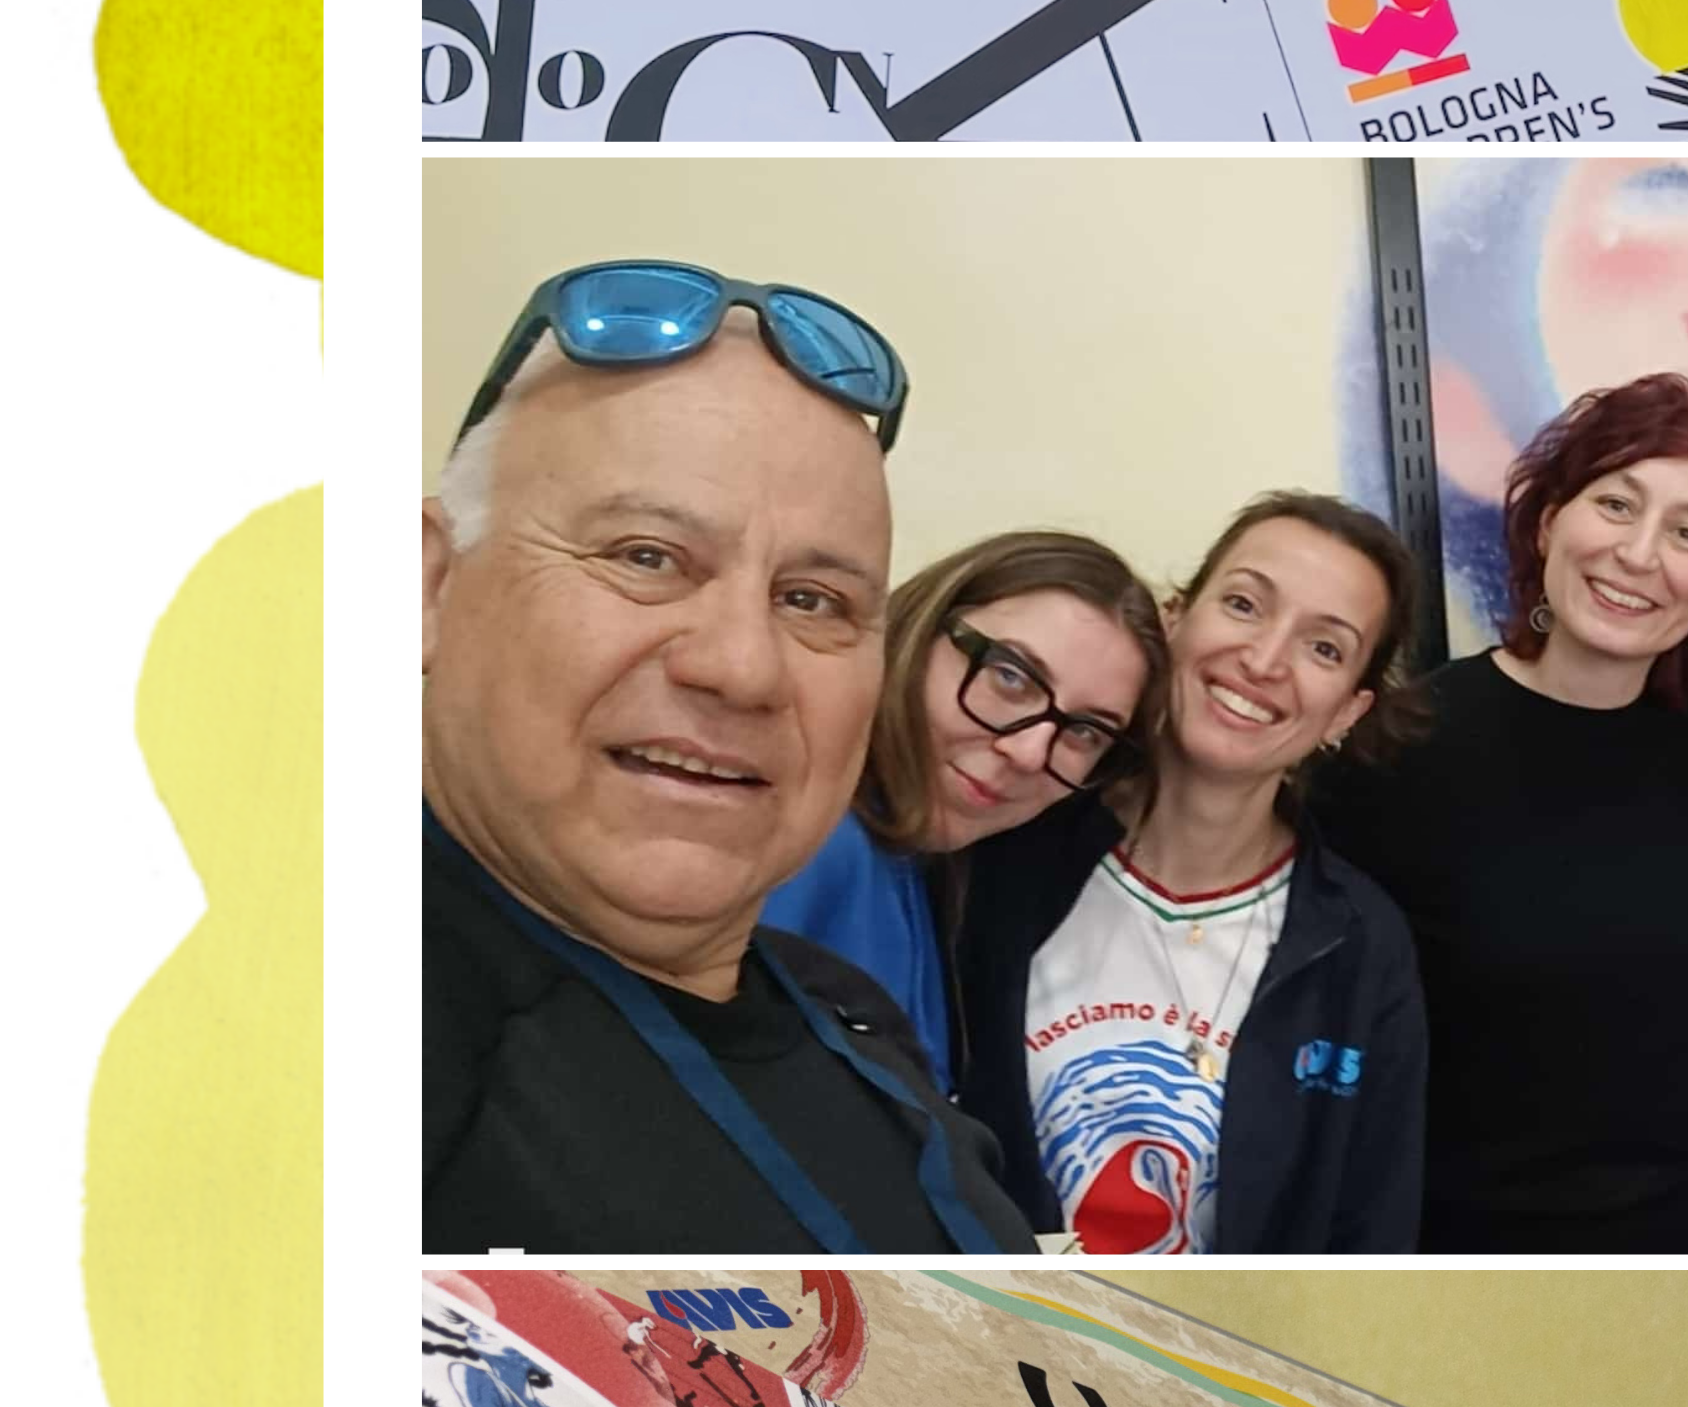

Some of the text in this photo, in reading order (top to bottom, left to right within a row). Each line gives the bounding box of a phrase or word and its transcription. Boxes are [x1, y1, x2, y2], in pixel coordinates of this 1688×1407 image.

[1360, 71, 1559, 142] BOLOGNA
[1025, 1002, 1154, 1052] lasciamo
[1163, 1002, 1180, 1026] è
[1185, 1010, 1221, 1038] la
[646, 1288, 793, 1332] AVIS
